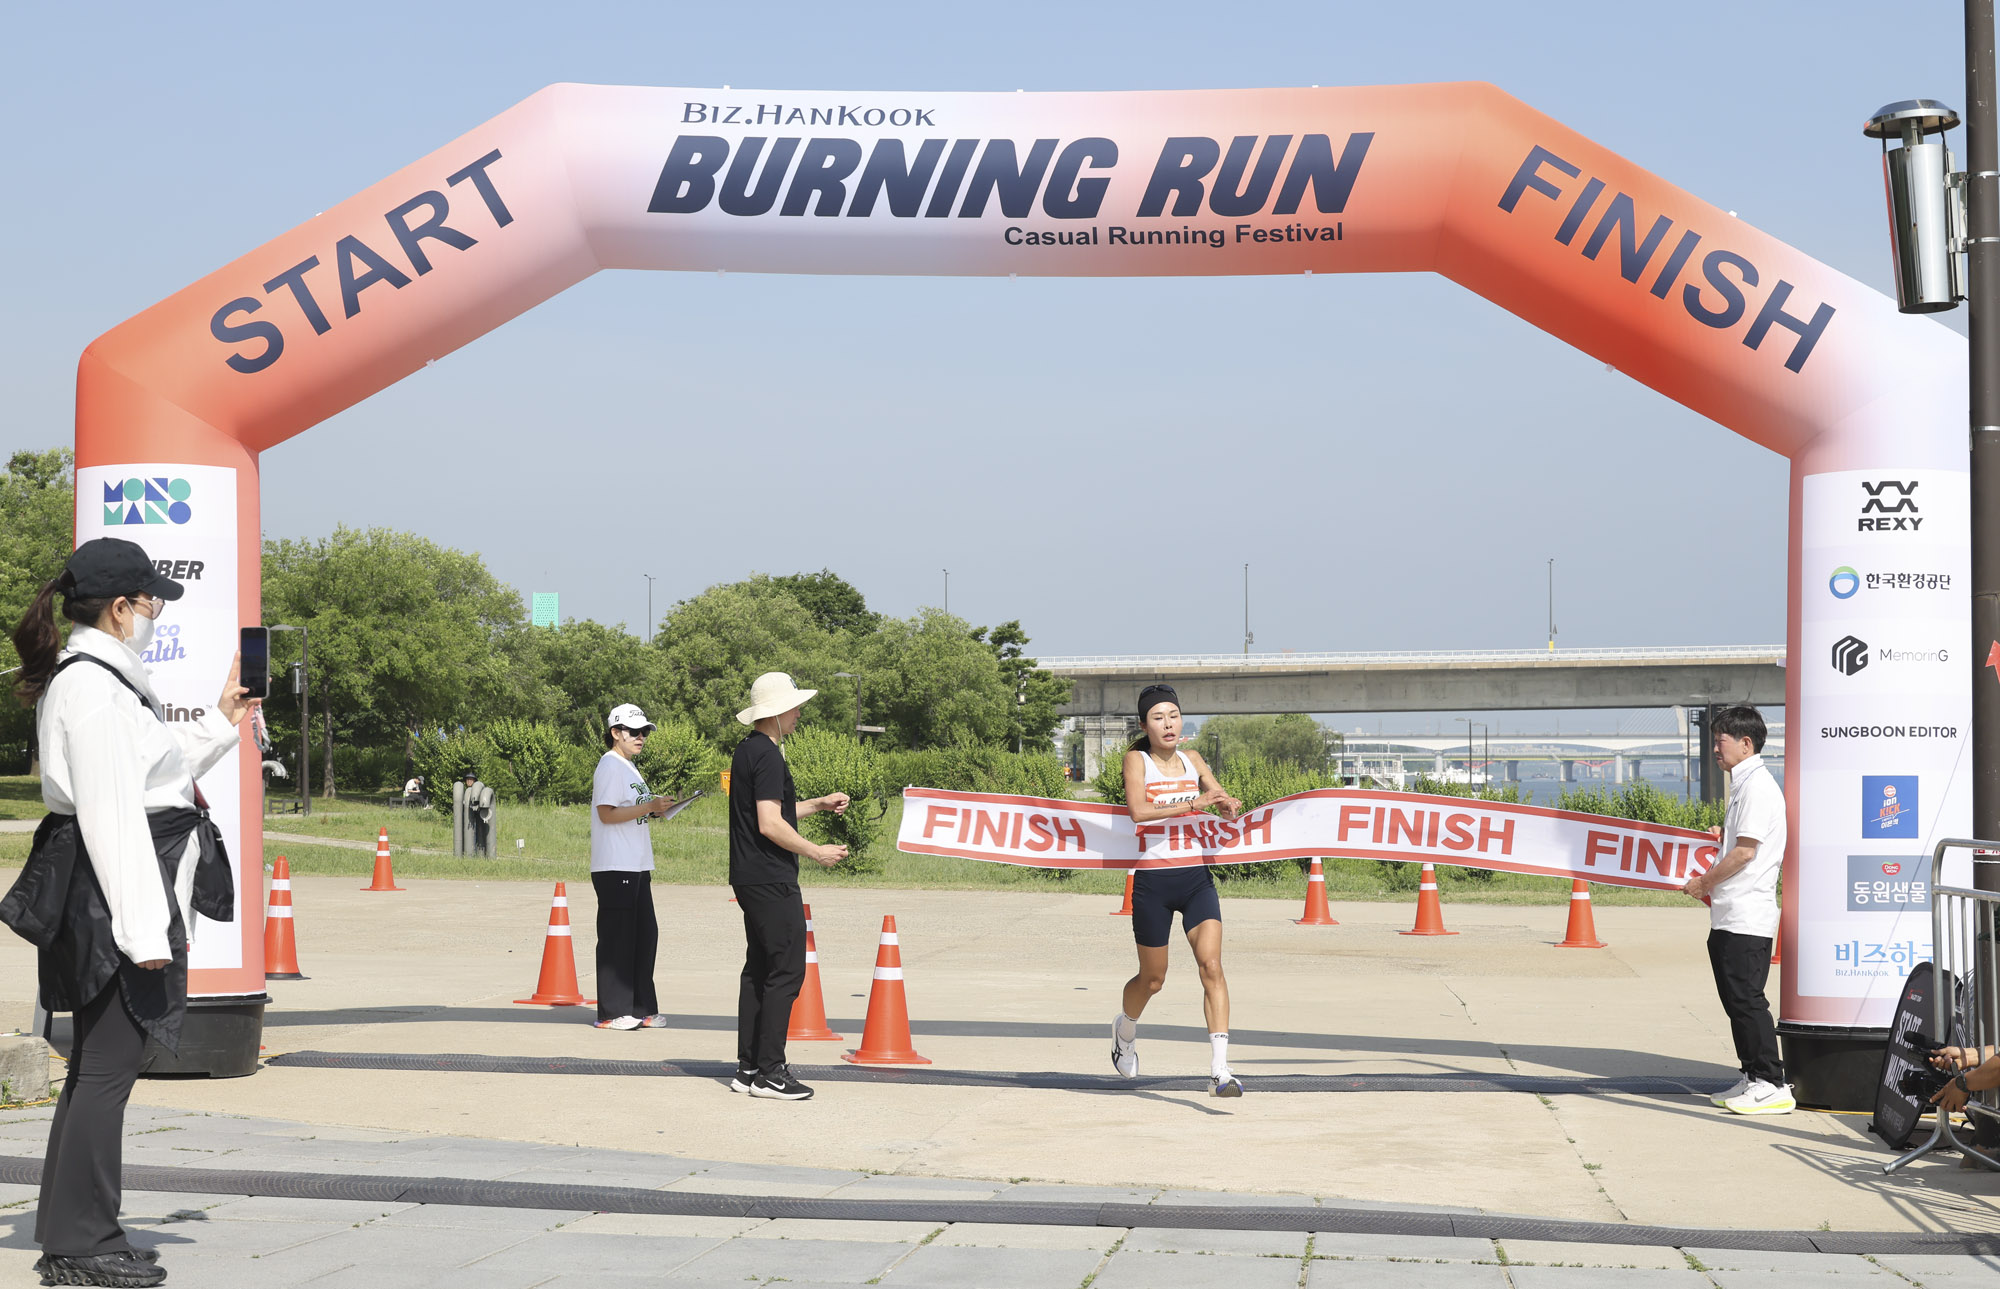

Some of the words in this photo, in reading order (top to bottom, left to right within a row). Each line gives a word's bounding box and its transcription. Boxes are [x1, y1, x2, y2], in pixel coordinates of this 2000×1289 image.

[647, 134, 1119, 220] BURNING
[1135, 132, 1376, 217] RUN
[1004, 226, 1099, 246] Casual
[1108, 225, 1226, 249] Running
[1235, 222, 1344, 243] Festival
[210, 147, 515, 374] START
[1497, 144, 1837, 375] FINISH
[1857, 517, 1924, 531] REXY
[151, 559, 205, 580] BER
[1865, 572, 1952, 590] 한국환경공단
[1879, 648, 1949, 663] MemorinG
[1821, 725, 1905, 739] SUNGBOON
[1909, 726, 1958, 739] EDITOR
[922, 804, 1087, 853] FINISH
[1135, 808, 1275, 853] FINISH
[1337, 804, 1516, 856] FINISH
[1584, 829, 1720, 879] FINIS
[1853, 880, 1927, 905] 동원샘물
